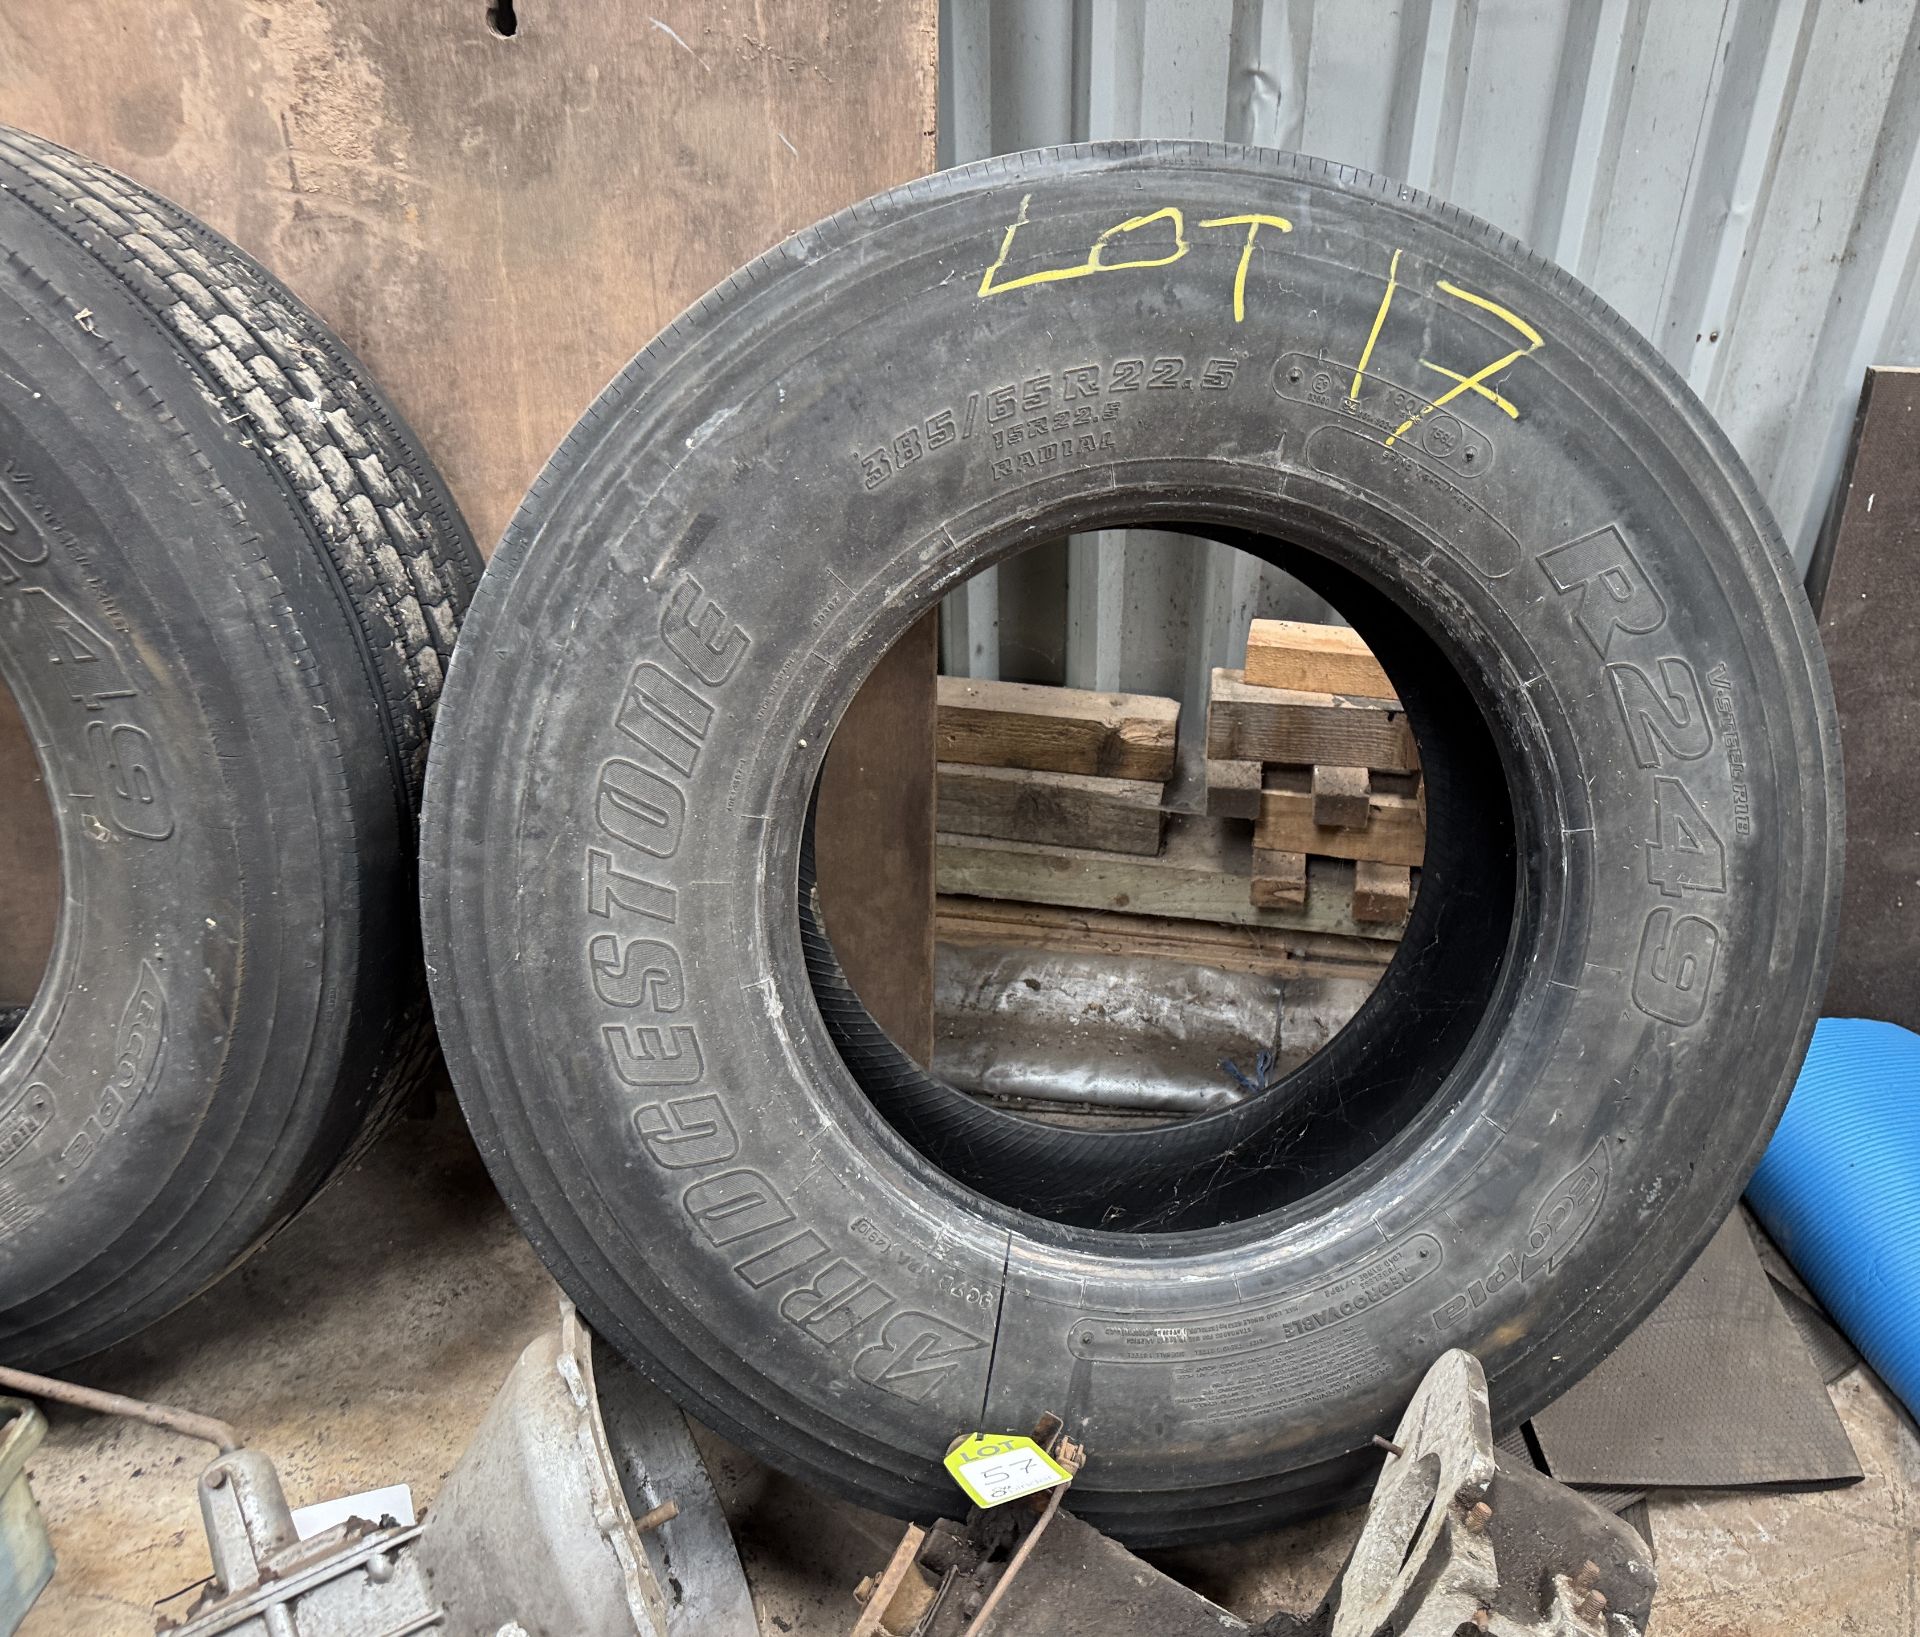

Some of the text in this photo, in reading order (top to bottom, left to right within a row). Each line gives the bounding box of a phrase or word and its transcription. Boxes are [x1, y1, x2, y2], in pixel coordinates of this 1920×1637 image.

[977, 194, 1545, 446] LOT 17
[863, 355, 1239, 492] 385/65R22.5
[990, 433, 1116, 482] RADIAL
[992, 401, 1122, 449] 15R22.5
[1536, 524, 1729, 1028] R249
[588, 574, 992, 1404] BRIDGESTONE
[1282, 1265, 1419, 1337] REGROOVABLE
[961, 1440, 1014, 1462] LOT
